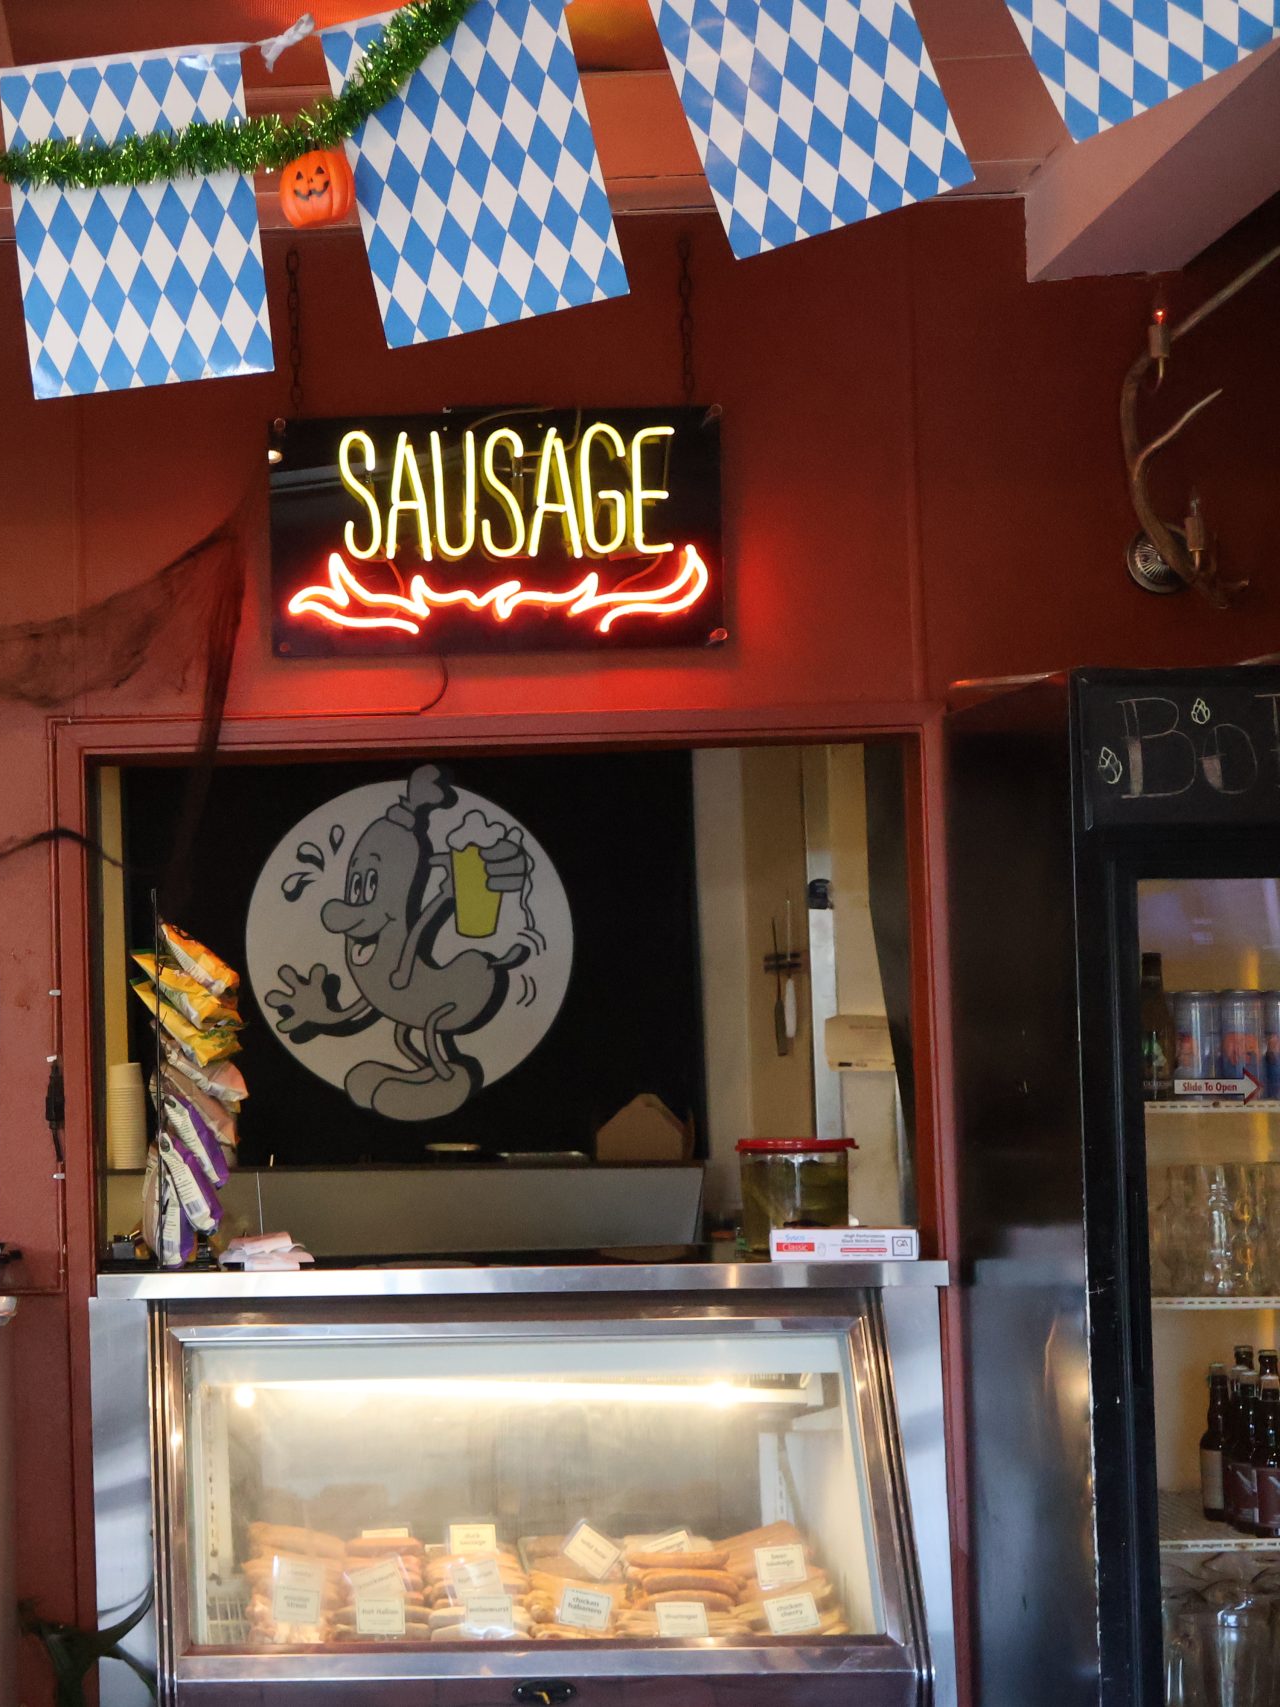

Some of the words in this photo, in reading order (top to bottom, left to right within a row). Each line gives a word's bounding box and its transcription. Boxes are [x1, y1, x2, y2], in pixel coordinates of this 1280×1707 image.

[338, 422, 675, 561] SAUSAGE
[1182, 1082, 1202, 1092] Slide
[1204, 1082, 1213, 1092] To
[1215, 1082, 1238, 1093] Open
[782, 1242, 809, 1252] Classic
[572, 1596, 600, 1608] chicken
[567, 1602, 602, 1615] habanero
